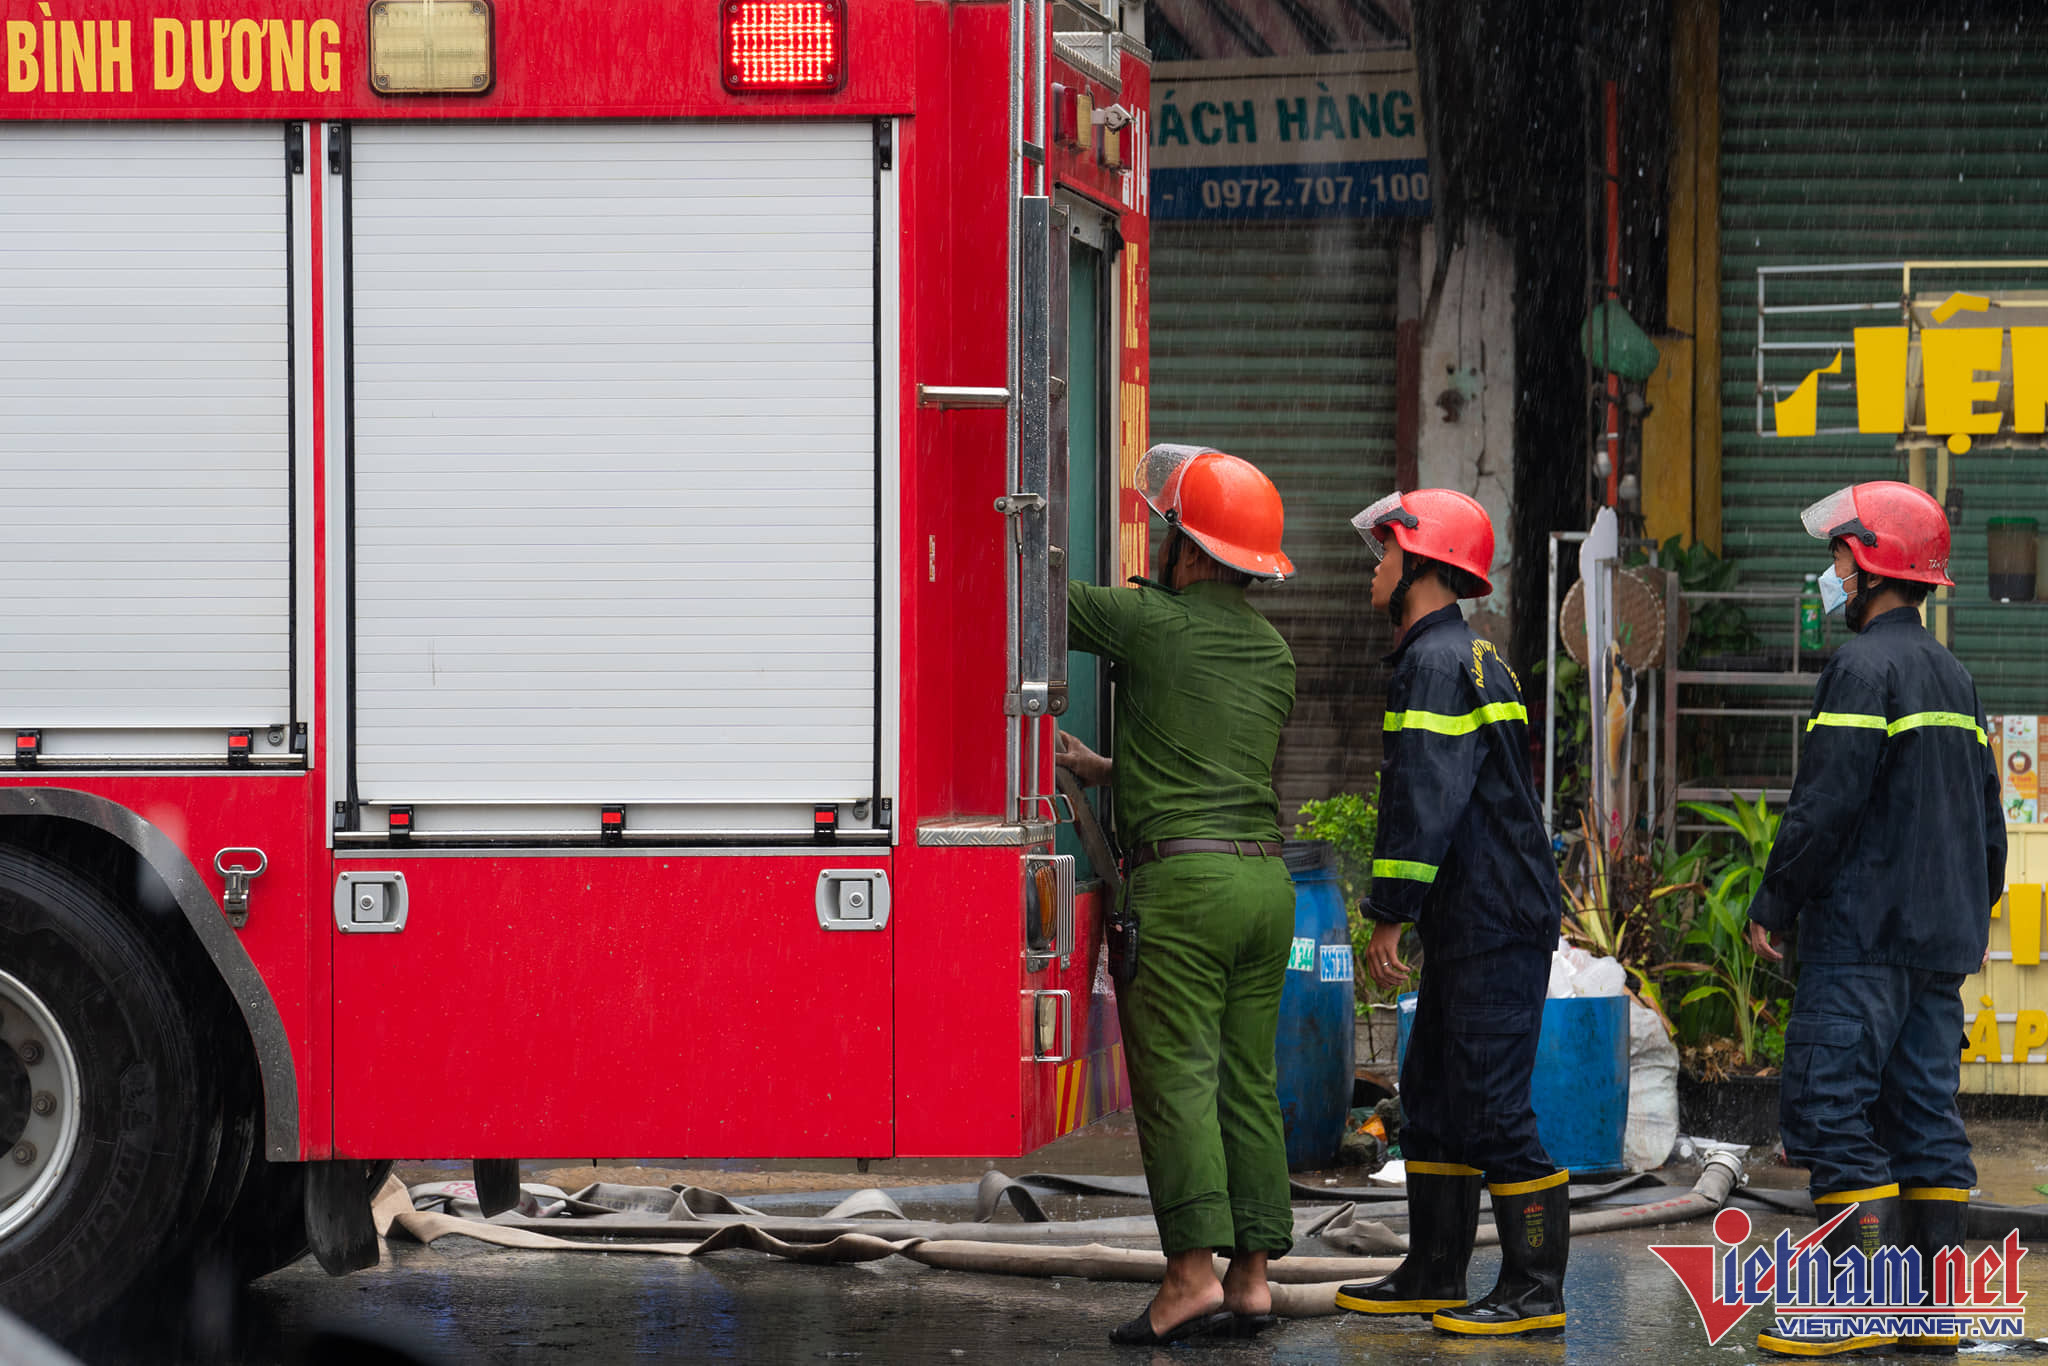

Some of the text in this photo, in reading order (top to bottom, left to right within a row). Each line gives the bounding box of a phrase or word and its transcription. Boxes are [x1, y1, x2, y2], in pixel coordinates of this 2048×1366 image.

[6, 1, 341, 93] BÌNH DƯƠNG
[1150, 81, 1416, 147] ÁCH HÀNG
[1202, 172, 1430, 209] 0972.707.100
[1125, 241, 1139, 349] XE
